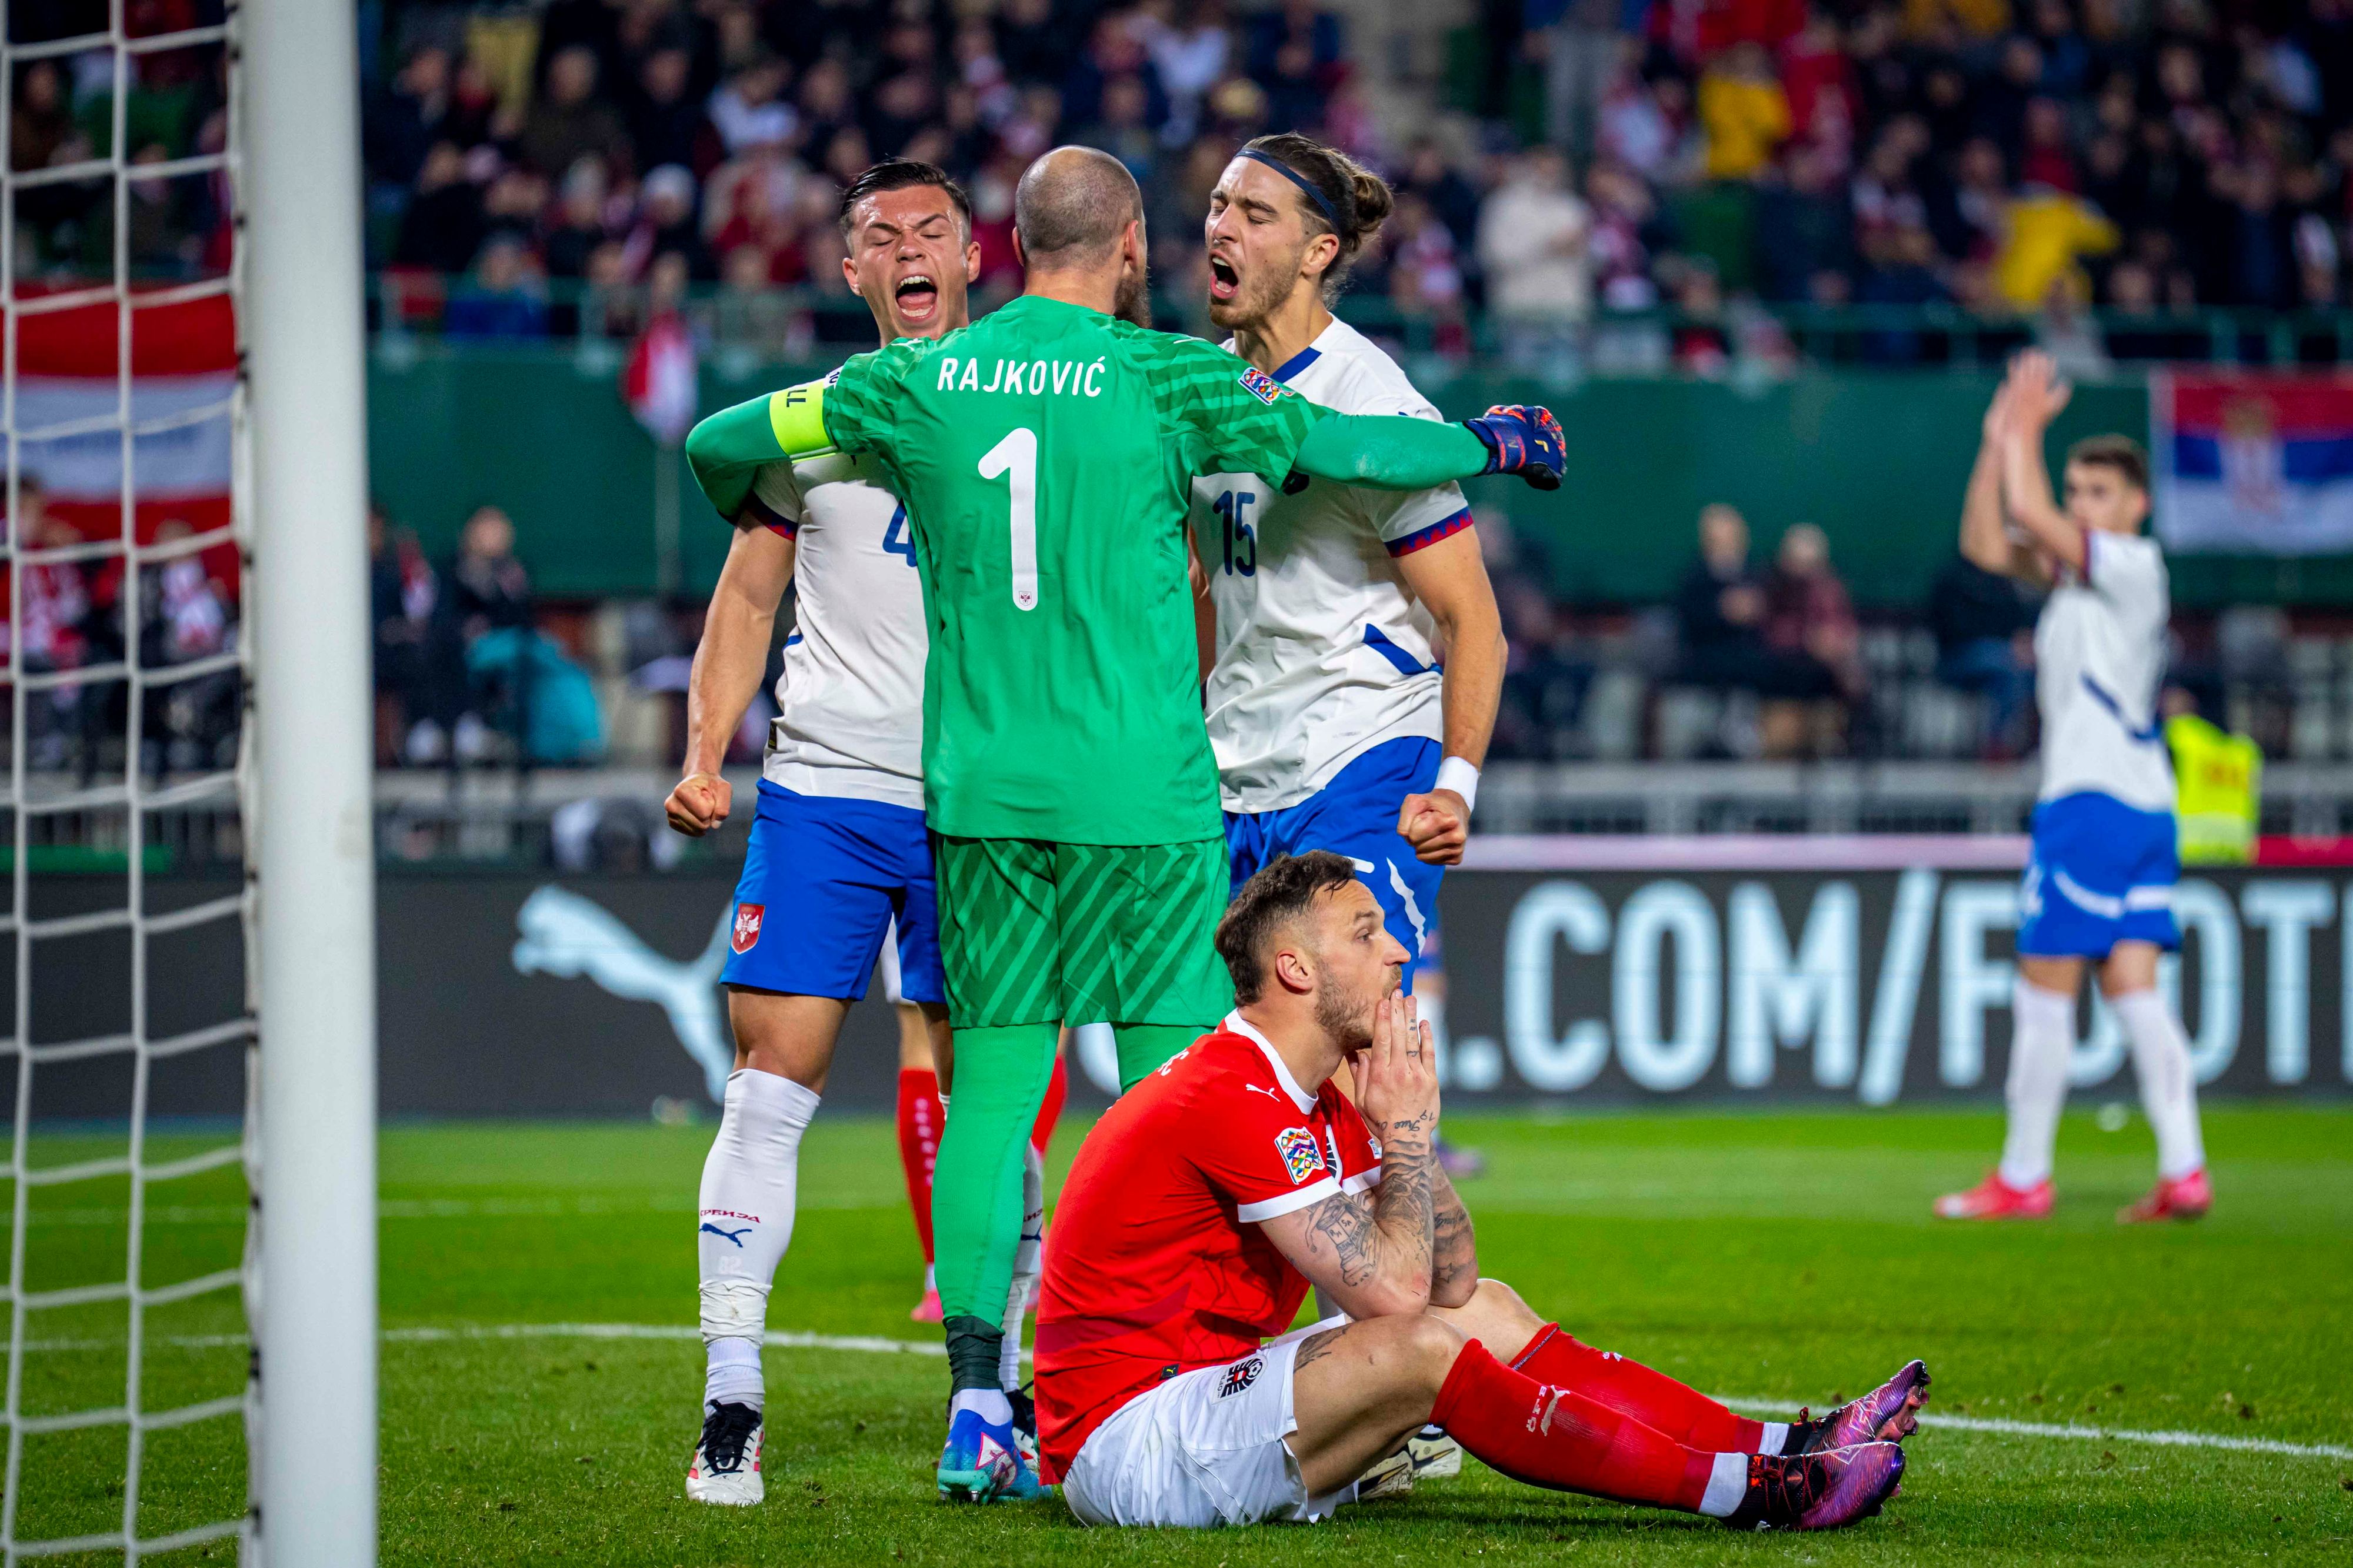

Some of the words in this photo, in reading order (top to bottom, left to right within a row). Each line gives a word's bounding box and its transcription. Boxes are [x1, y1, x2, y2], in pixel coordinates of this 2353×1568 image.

[936, 355, 1106, 398] RAJKOVIĆ
[882, 497, 918, 568] 4
[977, 426, 1038, 611] 1
[1212, 489, 1257, 578] 15
